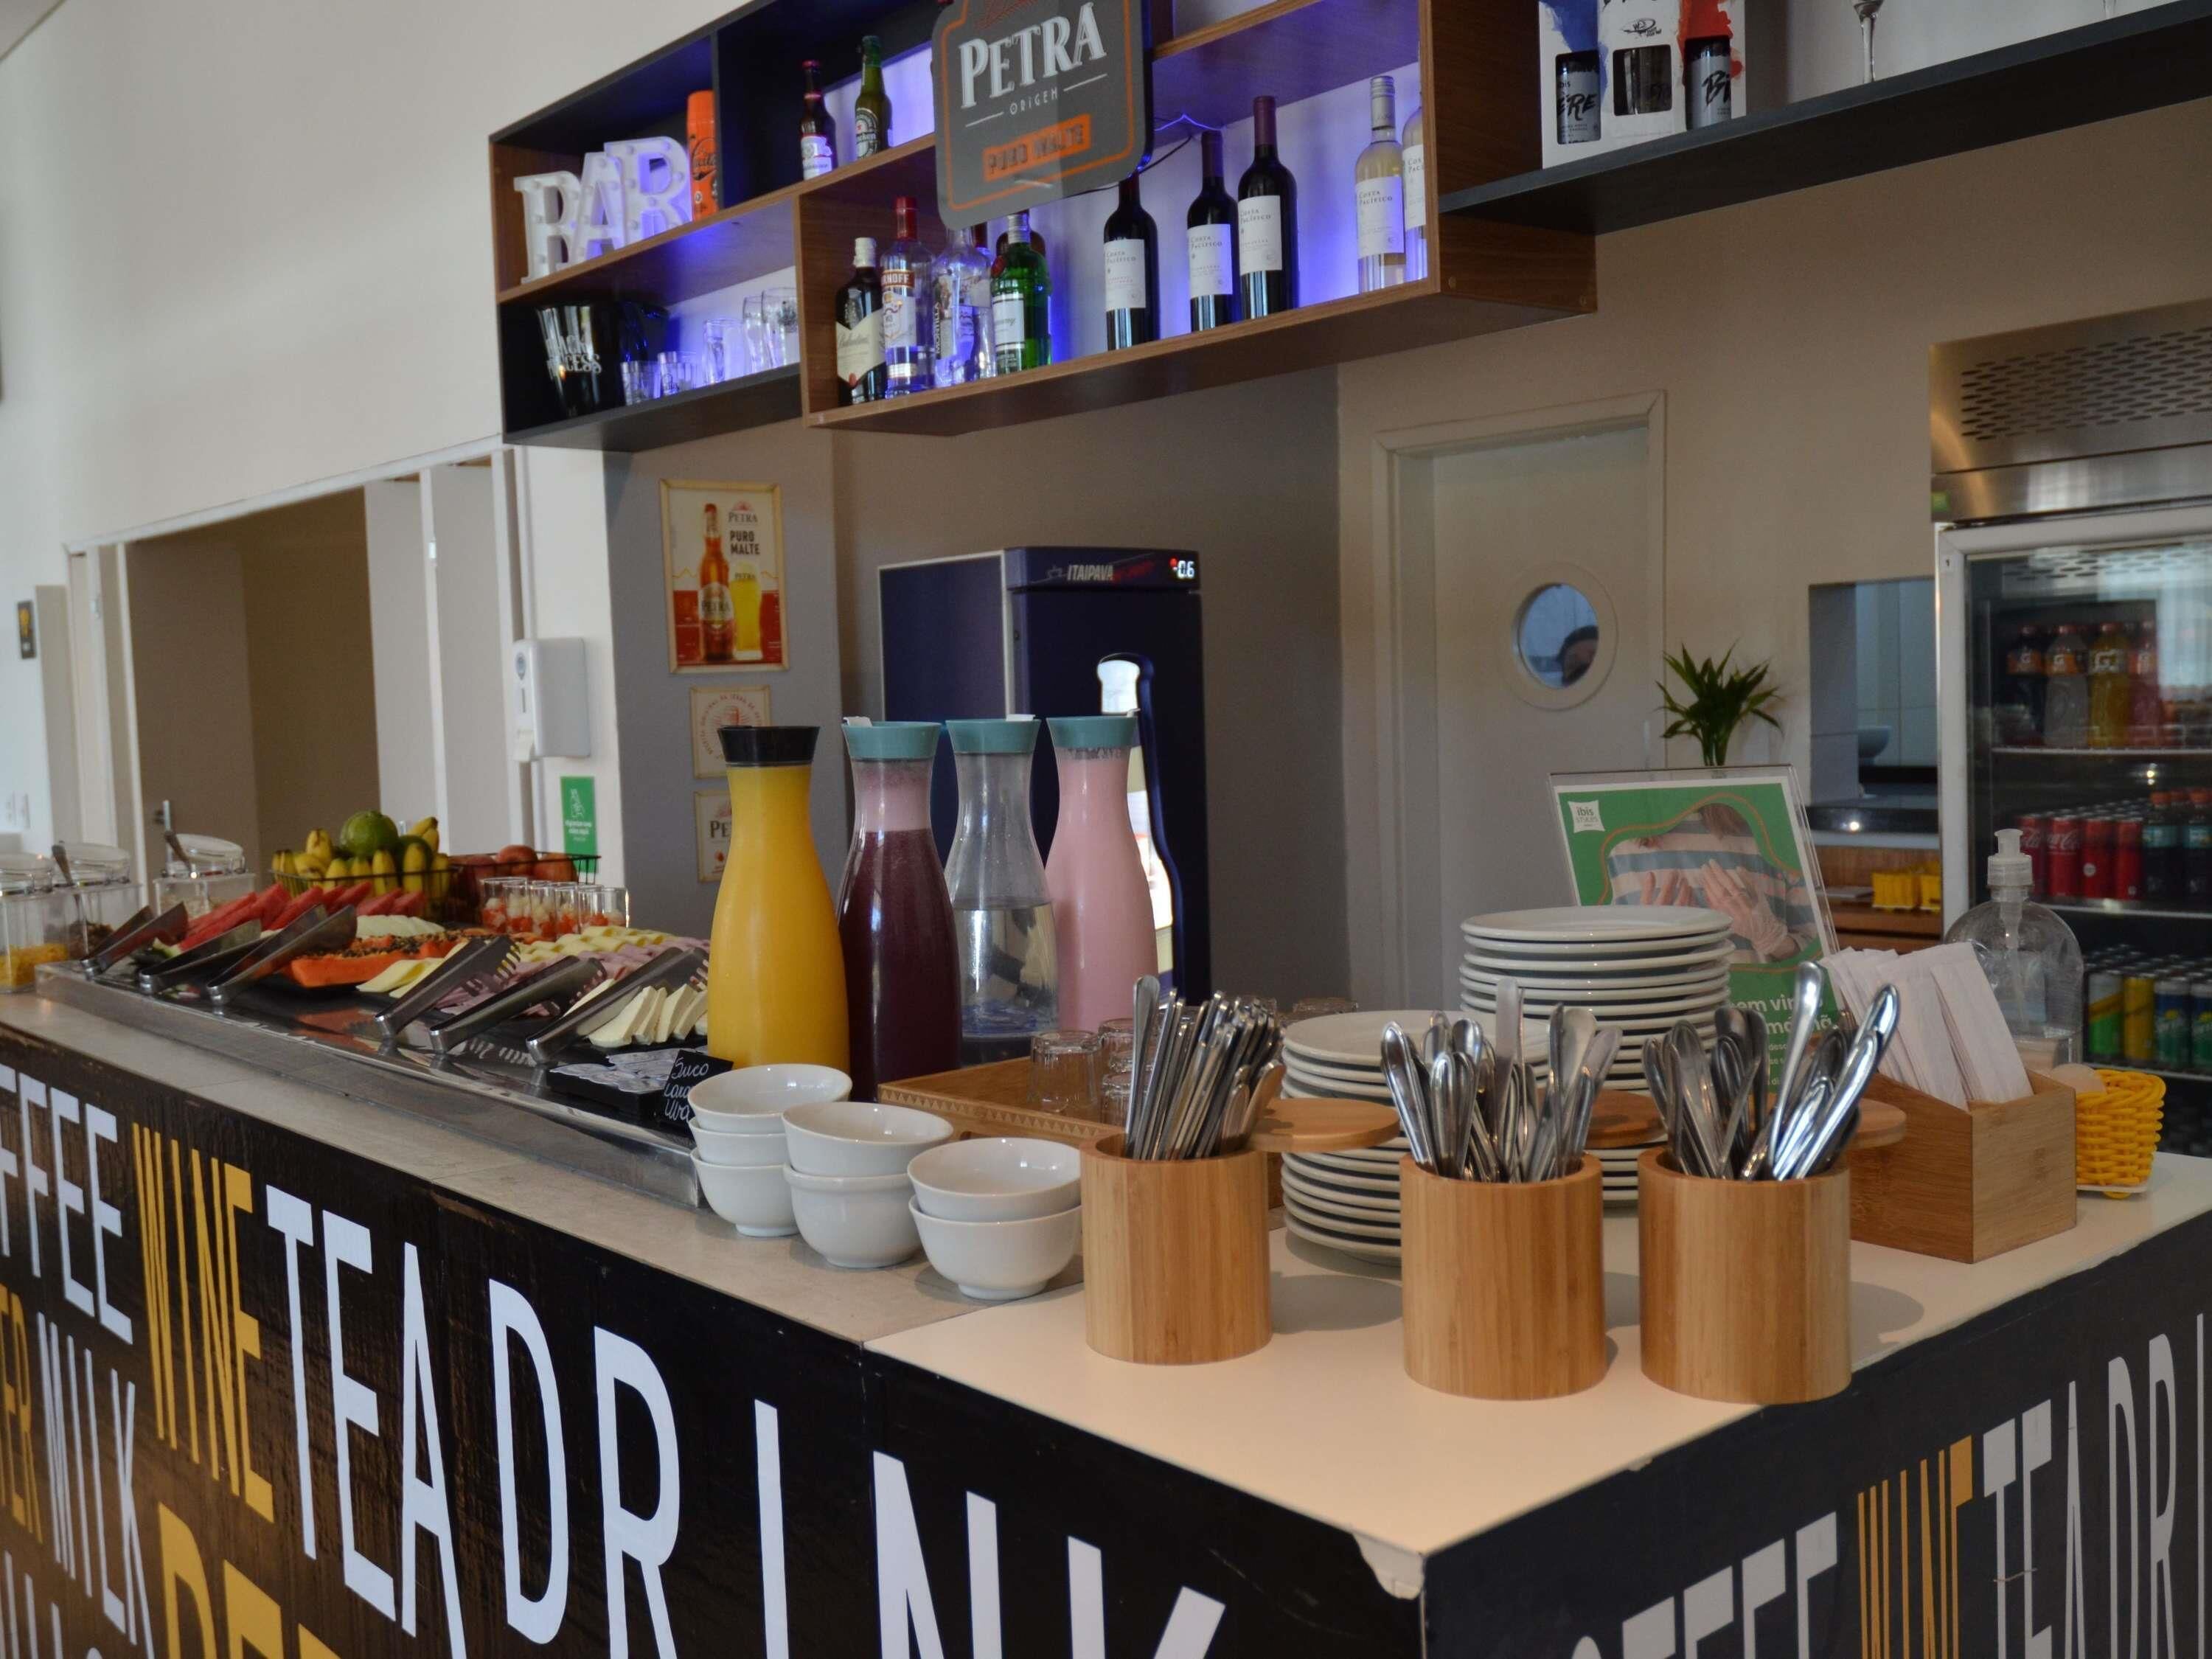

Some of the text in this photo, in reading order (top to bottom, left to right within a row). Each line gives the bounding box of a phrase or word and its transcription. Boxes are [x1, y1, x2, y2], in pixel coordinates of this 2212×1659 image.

[959, 1, 1107, 109] PETRA
[514, 136, 693, 285] BAR
[728, 512, 759, 523] PETRA
[729, 530, 755, 542] PURO
[731, 543, 761, 555] MALTE
[1067, 564, 1114, 582] ITAIPAVA
[1576, 806, 1594, 817] ibis
[671, 1057, 709, 1080] Suco
[664, 1082, 691, 1099] Lara
[664, 1099, 690, 1124] Uva
[133, 1122, 275, 1524] WINE
[266, 1184, 467, 1659] TEA
[38, 1312, 156, 1659] MILK
